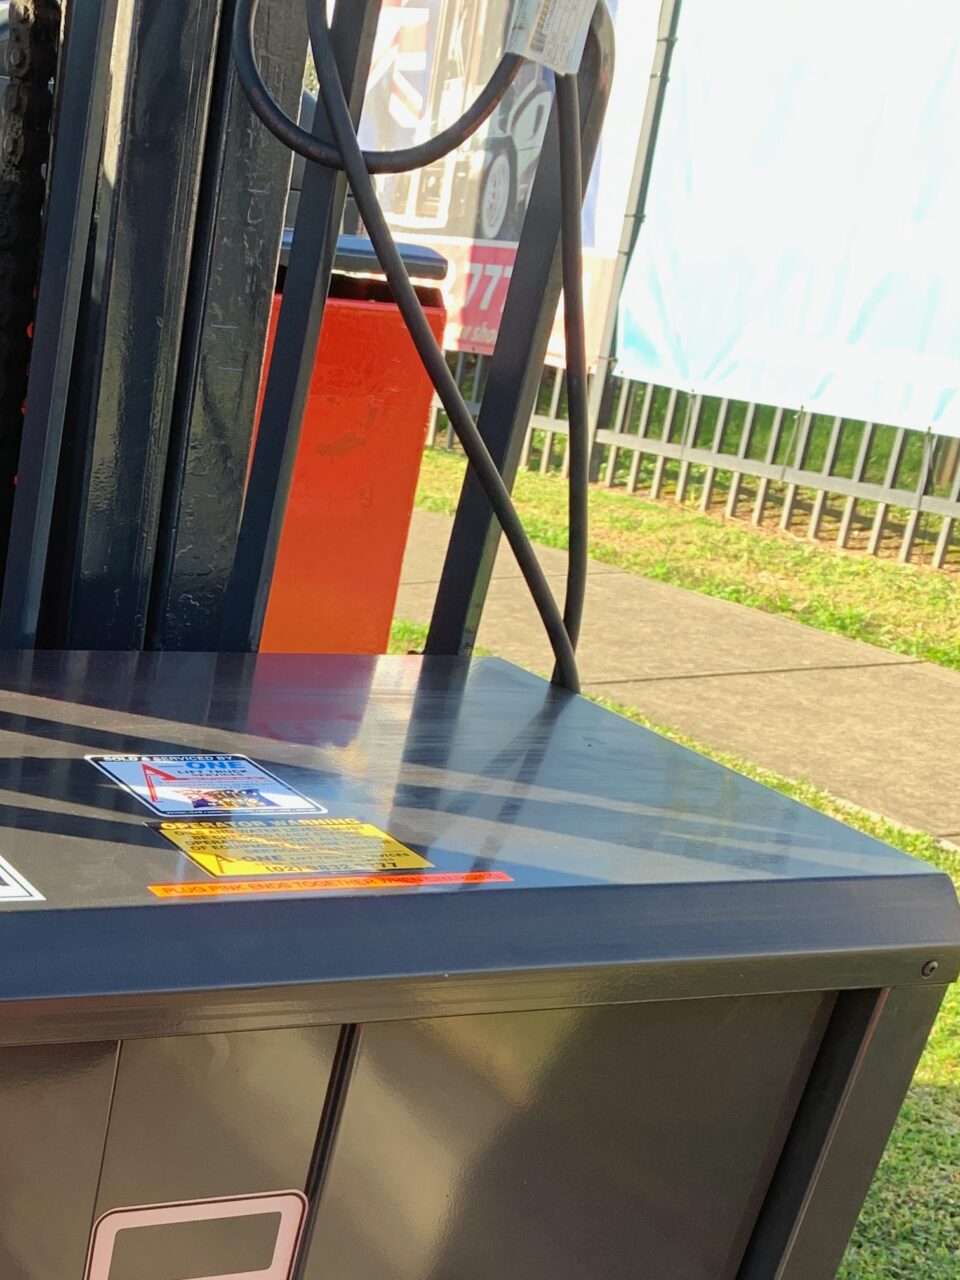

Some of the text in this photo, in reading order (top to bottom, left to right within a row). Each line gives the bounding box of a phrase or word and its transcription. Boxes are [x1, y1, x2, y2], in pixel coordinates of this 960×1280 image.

[159, 817, 361, 830] OPERATOR WARNING
[208, 882, 245, 892] PINK
